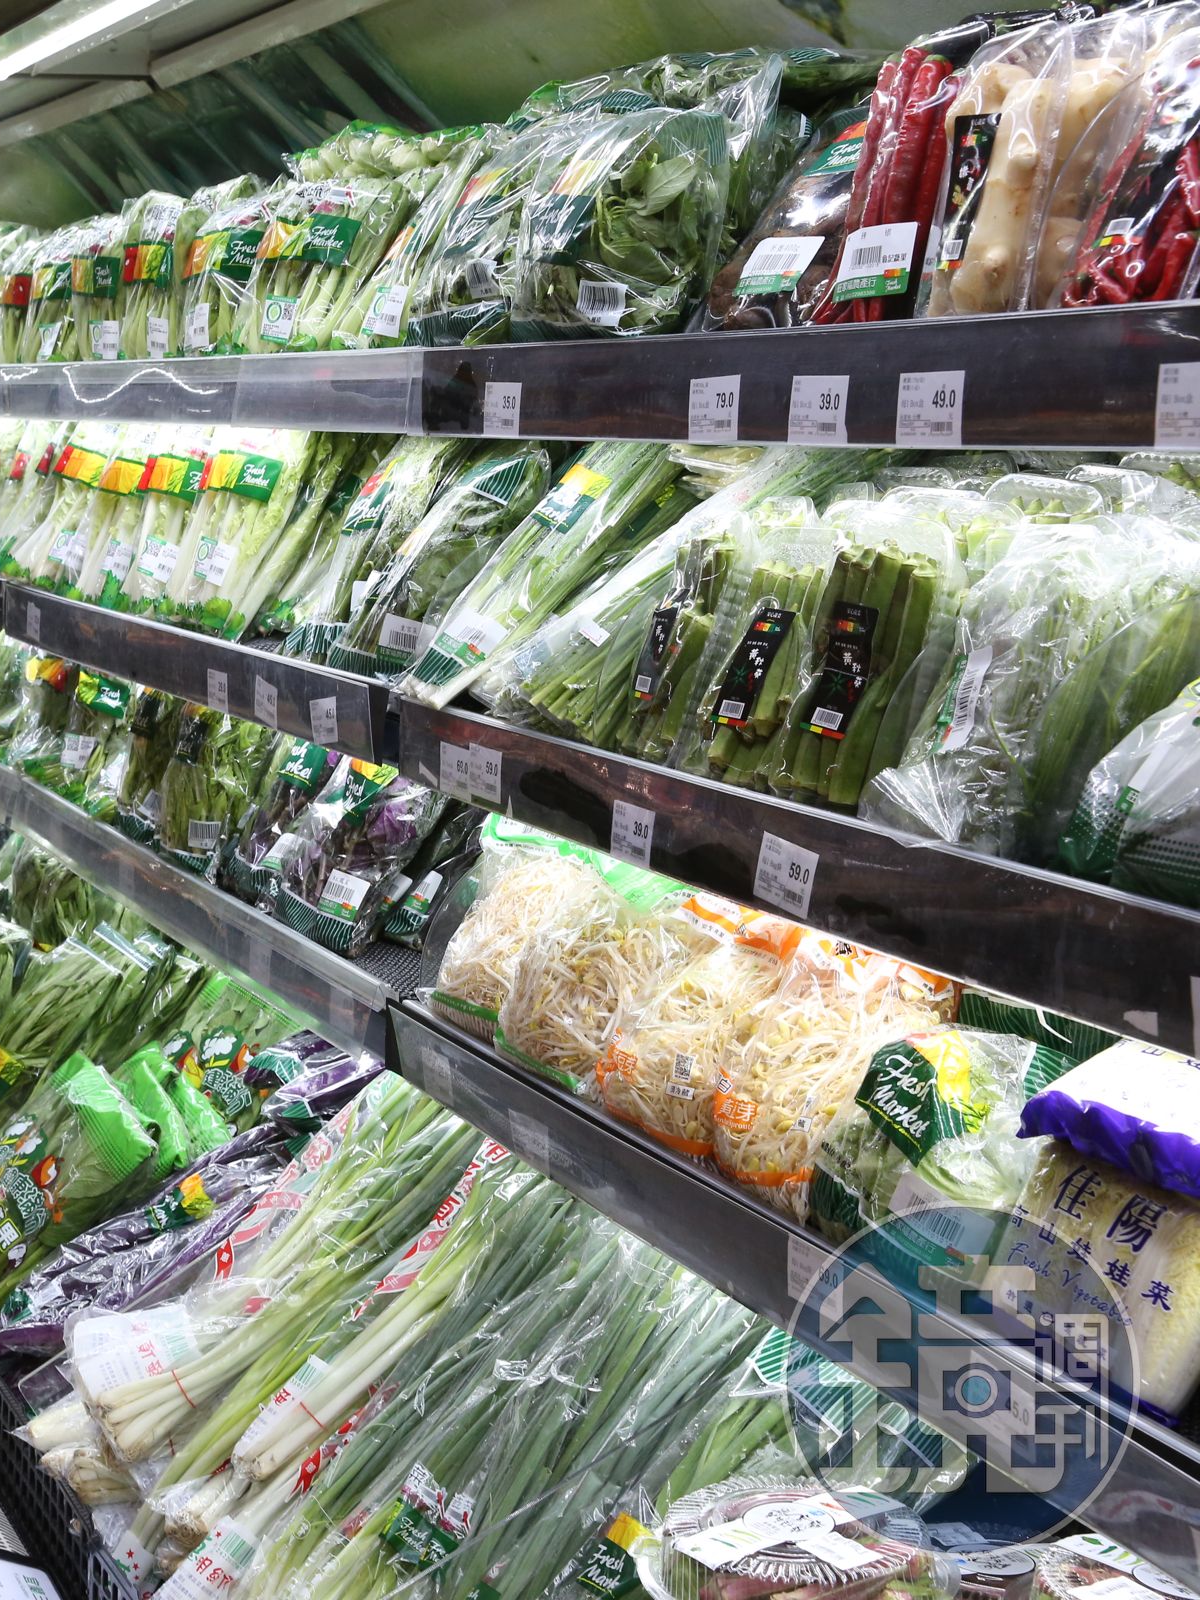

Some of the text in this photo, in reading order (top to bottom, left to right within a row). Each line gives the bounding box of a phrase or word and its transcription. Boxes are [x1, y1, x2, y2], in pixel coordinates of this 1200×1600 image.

[311, 224, 339, 238] Fresh
[309, 236, 345, 249] Market
[502, 395, 516, 411] 35.0
[716, 391, 734, 410] 79.0
[819, 392, 840, 411] 39.0
[932, 388, 956, 409] 49.0
[632, 820, 649, 840] 39.0
[788, 862, 810, 886] 59.0
[881, 1055, 937, 1100] Fresh
[873, 1084, 932, 1139] Market
[1052, 1164, 1168, 1253] 佳陽
[1007, 1241, 1052, 1279] Fresh
[400, 1516, 427, 1541] Fresh
[588, 1543, 625, 1574] Fresh
